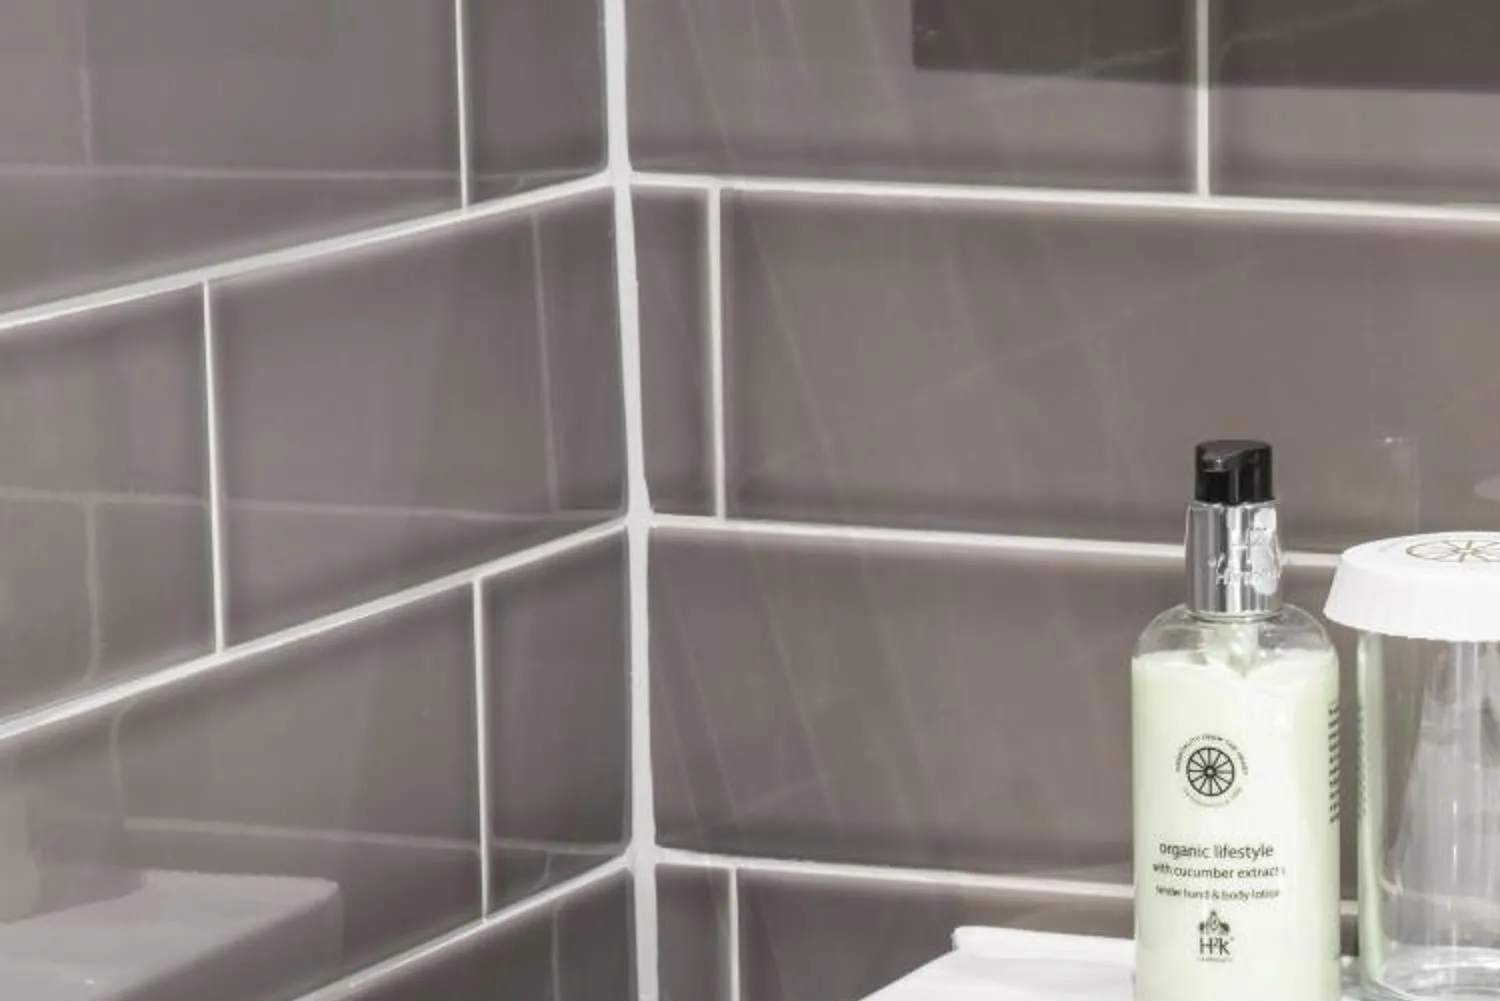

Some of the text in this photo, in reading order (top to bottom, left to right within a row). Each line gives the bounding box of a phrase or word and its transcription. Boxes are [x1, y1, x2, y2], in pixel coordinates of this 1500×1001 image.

[1159, 843, 1275, 861] organic lifestyle
[1174, 866, 1235, 878] cucumber
[1237, 866, 1286, 878] extract
